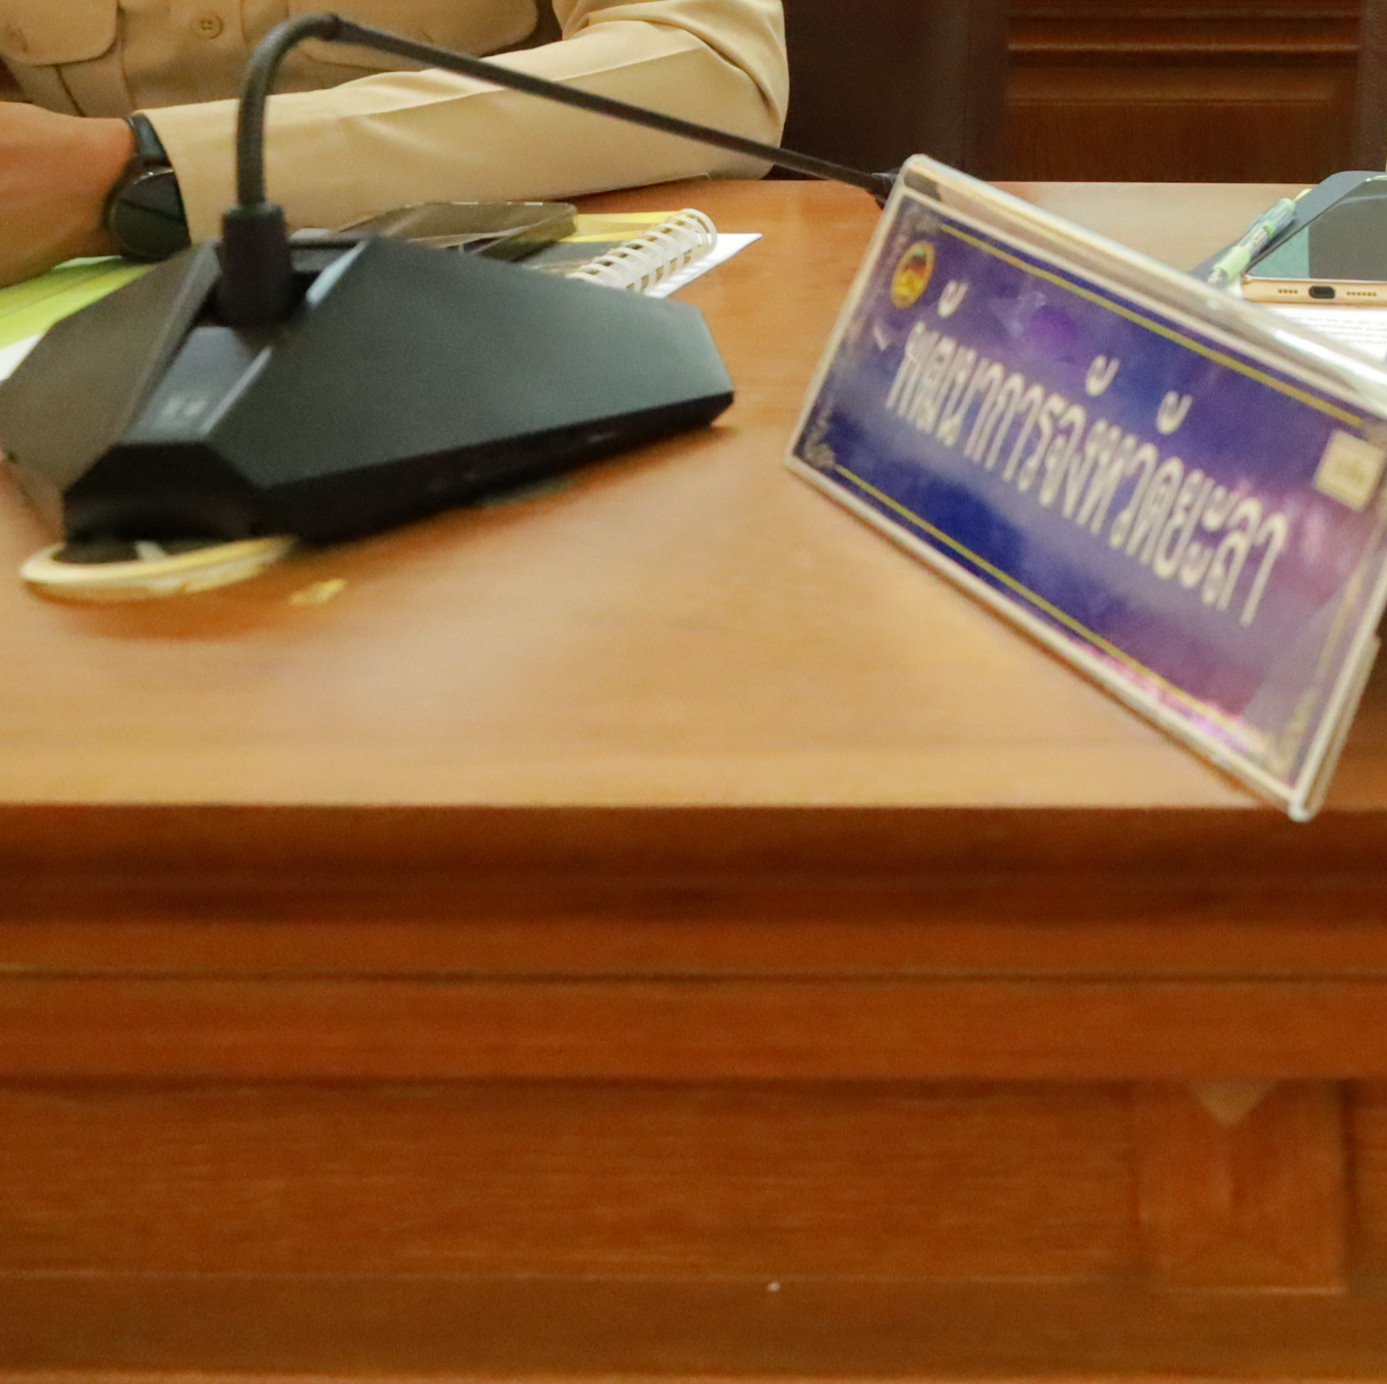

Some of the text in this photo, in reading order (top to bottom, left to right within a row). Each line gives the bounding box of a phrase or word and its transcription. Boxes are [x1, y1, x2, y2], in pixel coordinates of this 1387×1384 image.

[885, 278, 1289, 629] พัฒนาการจังหวัดยะลา
